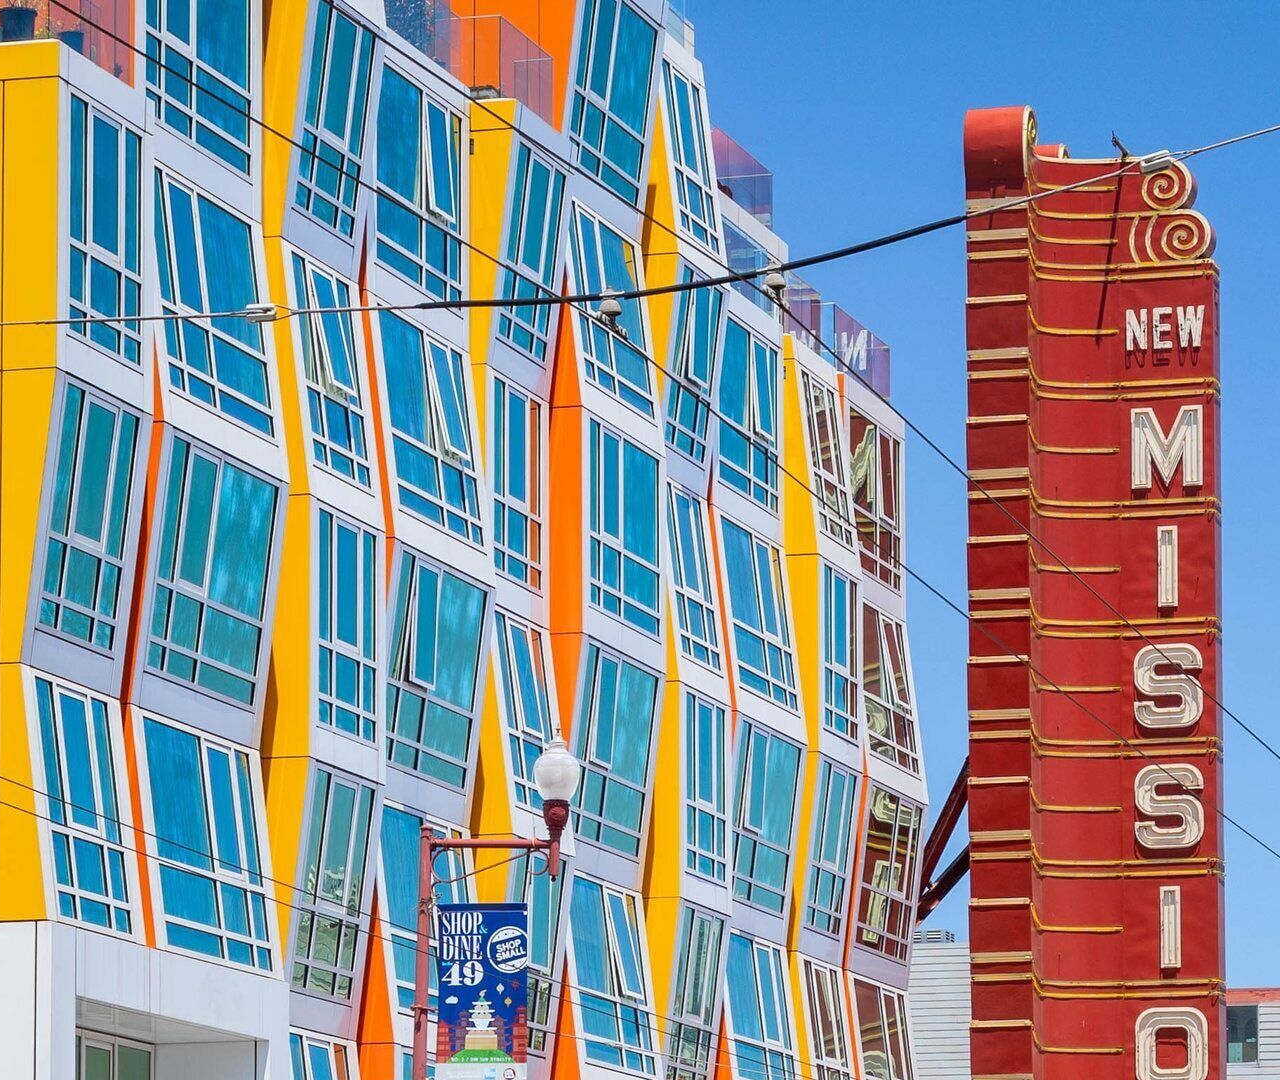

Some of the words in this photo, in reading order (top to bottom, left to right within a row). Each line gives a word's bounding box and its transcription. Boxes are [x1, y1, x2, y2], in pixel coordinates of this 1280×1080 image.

[1125, 304, 1206, 352] NEW
[442, 912, 483, 935] SHOP
[442, 935, 483, 961] DINE
[495, 939, 522, 953] SHOP
[495, 947, 526, 962] SMALL
[441, 960, 484, 987] 49
